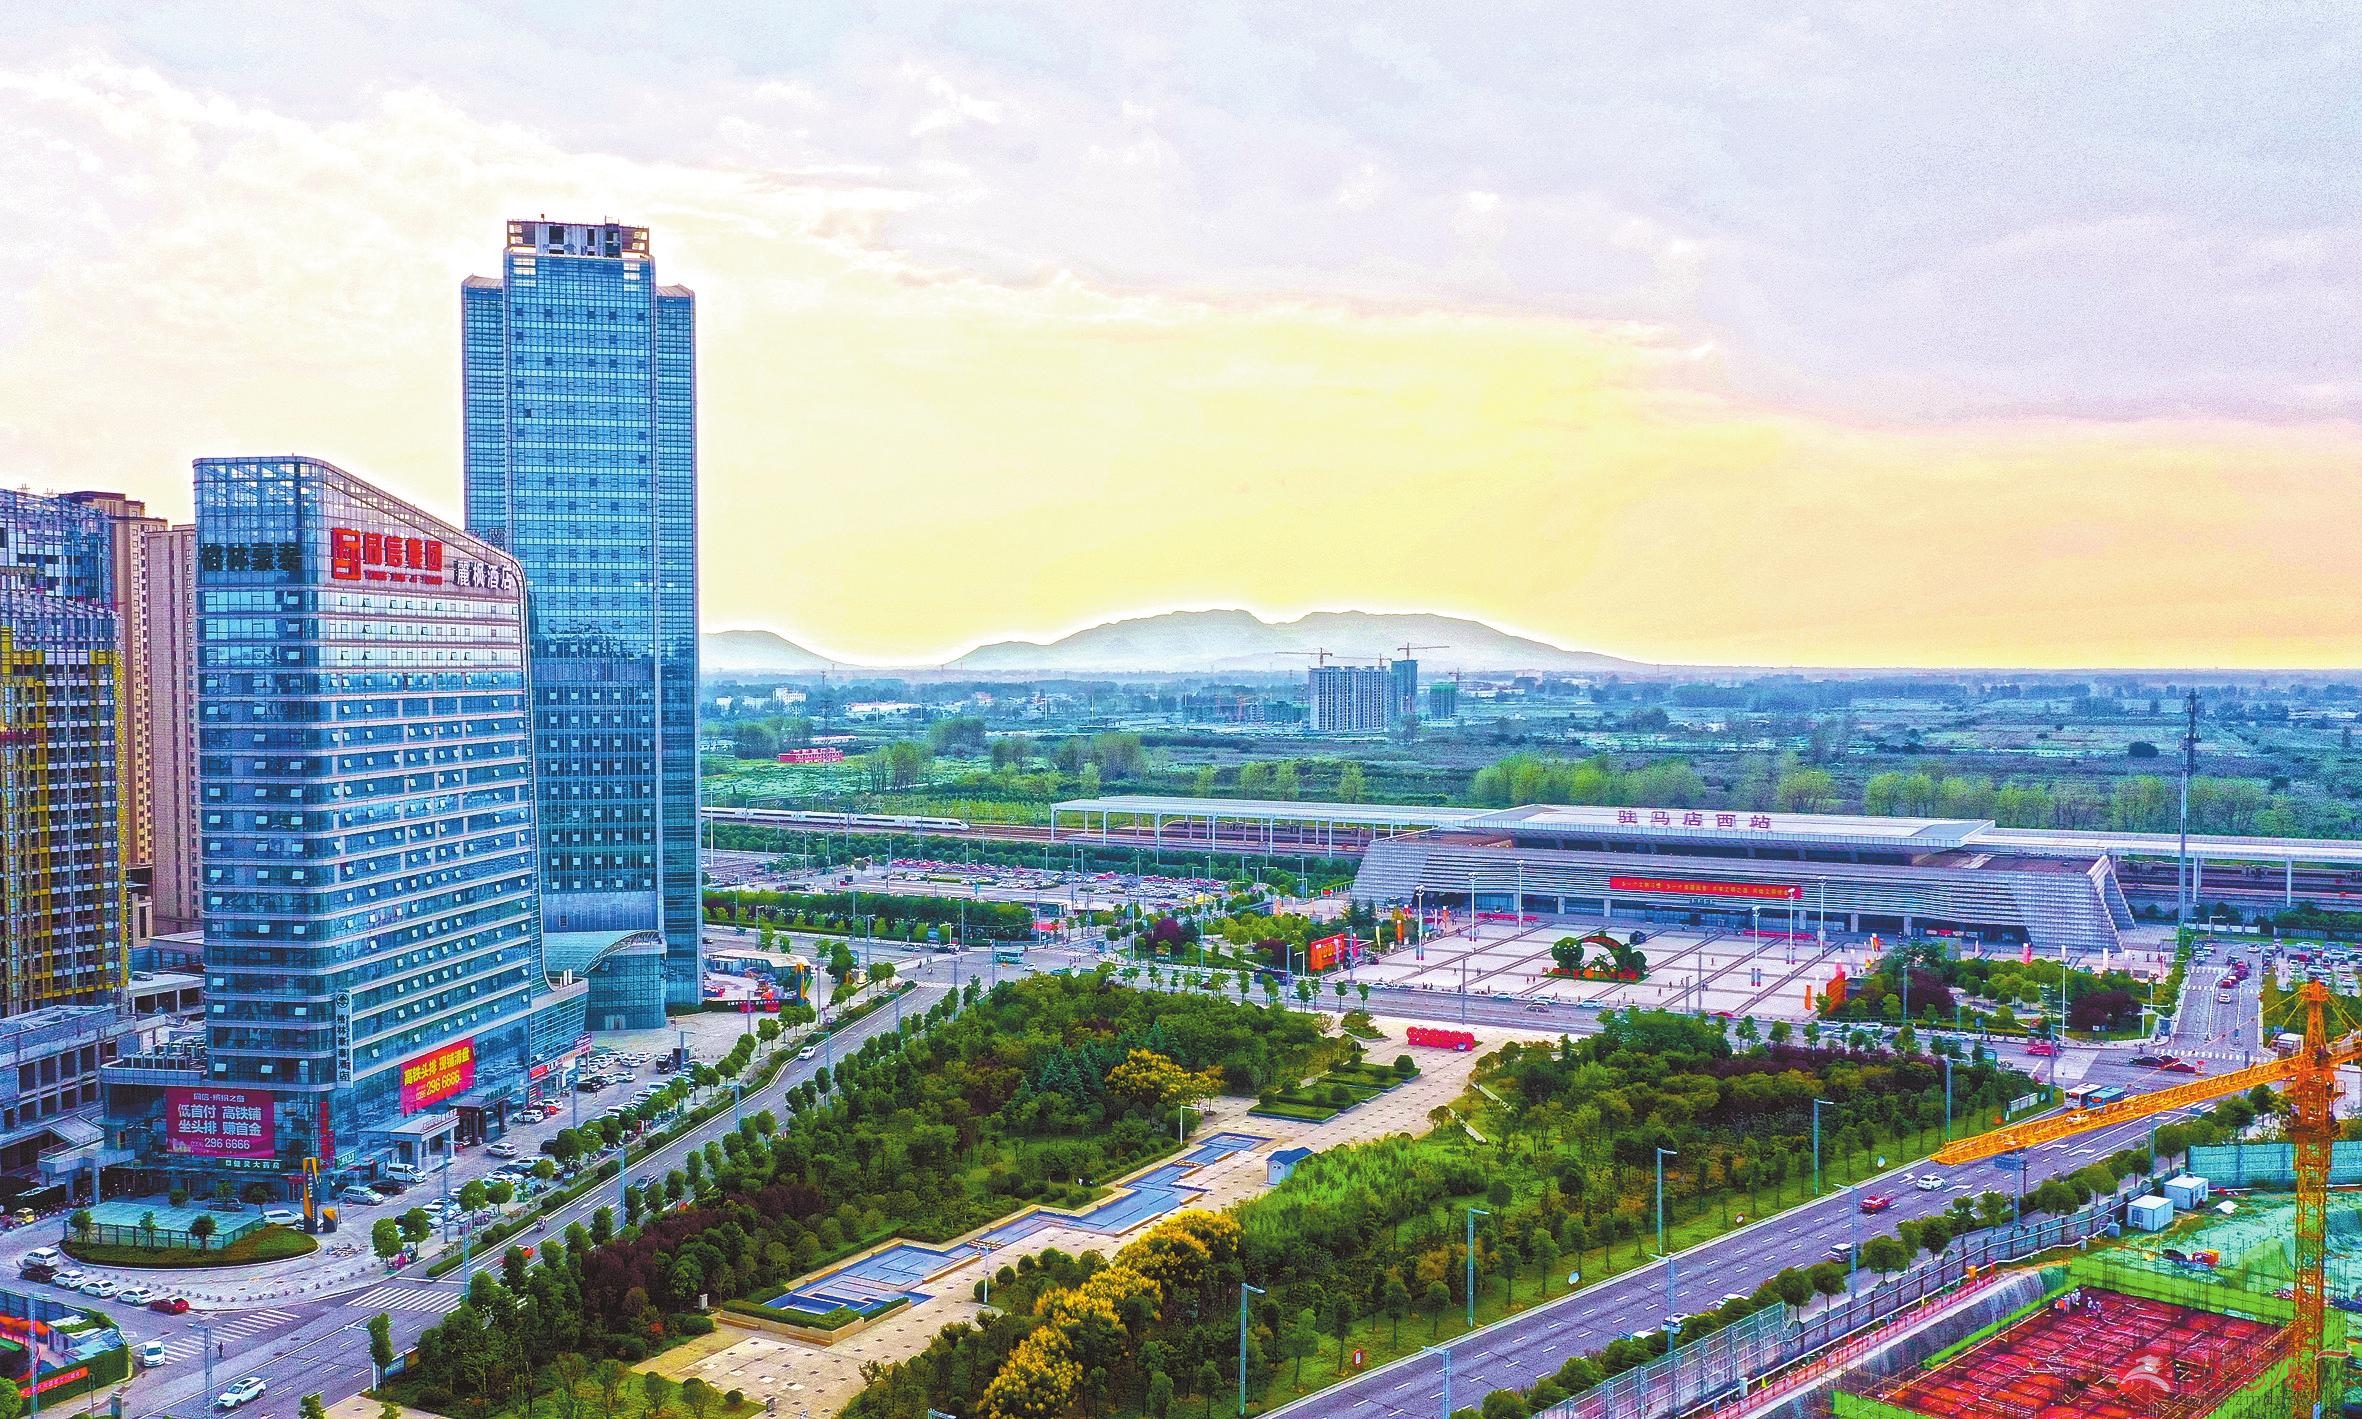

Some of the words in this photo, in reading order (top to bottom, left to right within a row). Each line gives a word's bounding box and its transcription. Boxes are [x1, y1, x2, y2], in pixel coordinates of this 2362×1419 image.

[1617, 810, 1772, 829] 驻马店西站
[404, 1059, 438, 1086] 高铁头排
[426, 1077, 441, 1096] 296
[441, 1070, 461, 1089] 6666
[177, 1104, 217, 1119] 低首付
[221, 1105, 262, 1121] 高铁铺
[178, 1119, 218, 1135] 坐头排
[222, 1121, 262, 1136] 赚首金
[204, 1137, 223, 1149] 296
[225, 1138, 251, 1150] 6666
